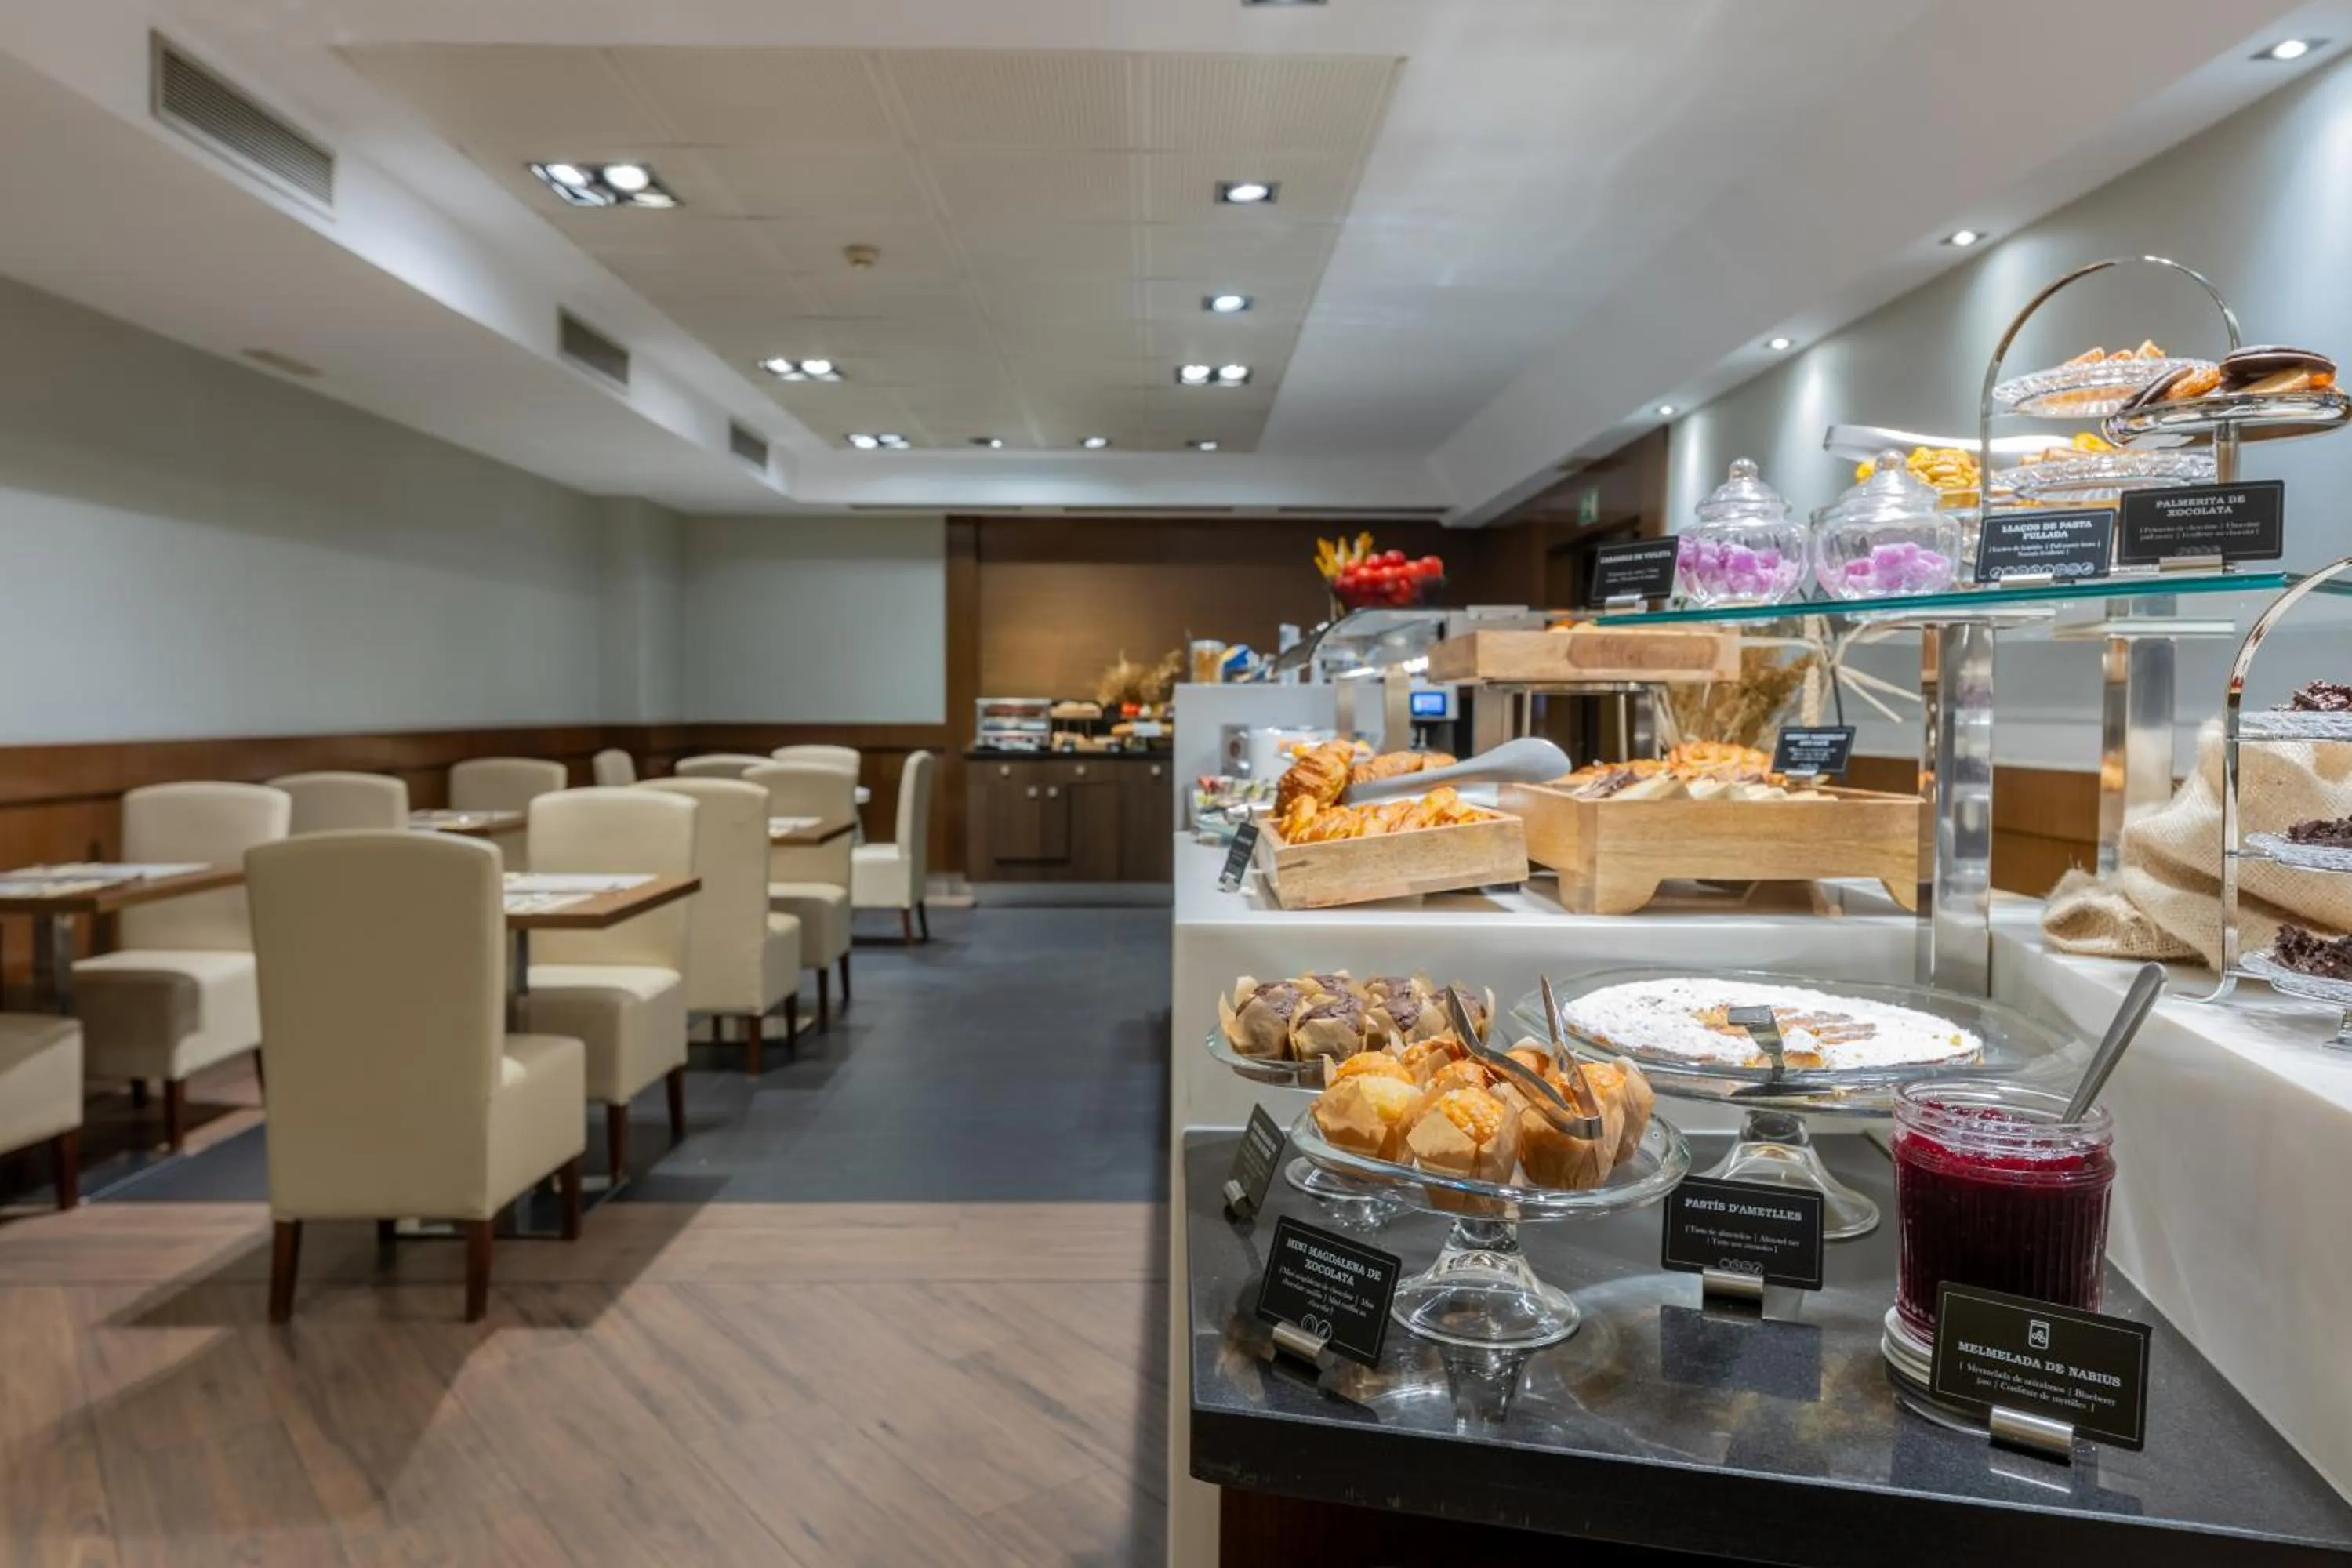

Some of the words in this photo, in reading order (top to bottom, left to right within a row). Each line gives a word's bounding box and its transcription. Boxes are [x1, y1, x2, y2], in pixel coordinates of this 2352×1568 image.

[2155, 496, 2225, 509] PALMERITA
[2227, 494, 2245, 504] DE
[2166, 505, 2233, 517] XOCOLATA
[2060, 521, 2092, 529] PASTA
[1286, 1237, 1308, 1254] MINI
[1308, 1246, 1364, 1276] MAGDALENA
[1367, 1267, 1382, 1282] DE
[1304, 1258, 1354, 1287] XOCOLATA
[1958, 1341, 2042, 1369] MELMELADA
[2045, 1360, 2065, 1374] DE
[2068, 1367, 2121, 1387] NABIUS
